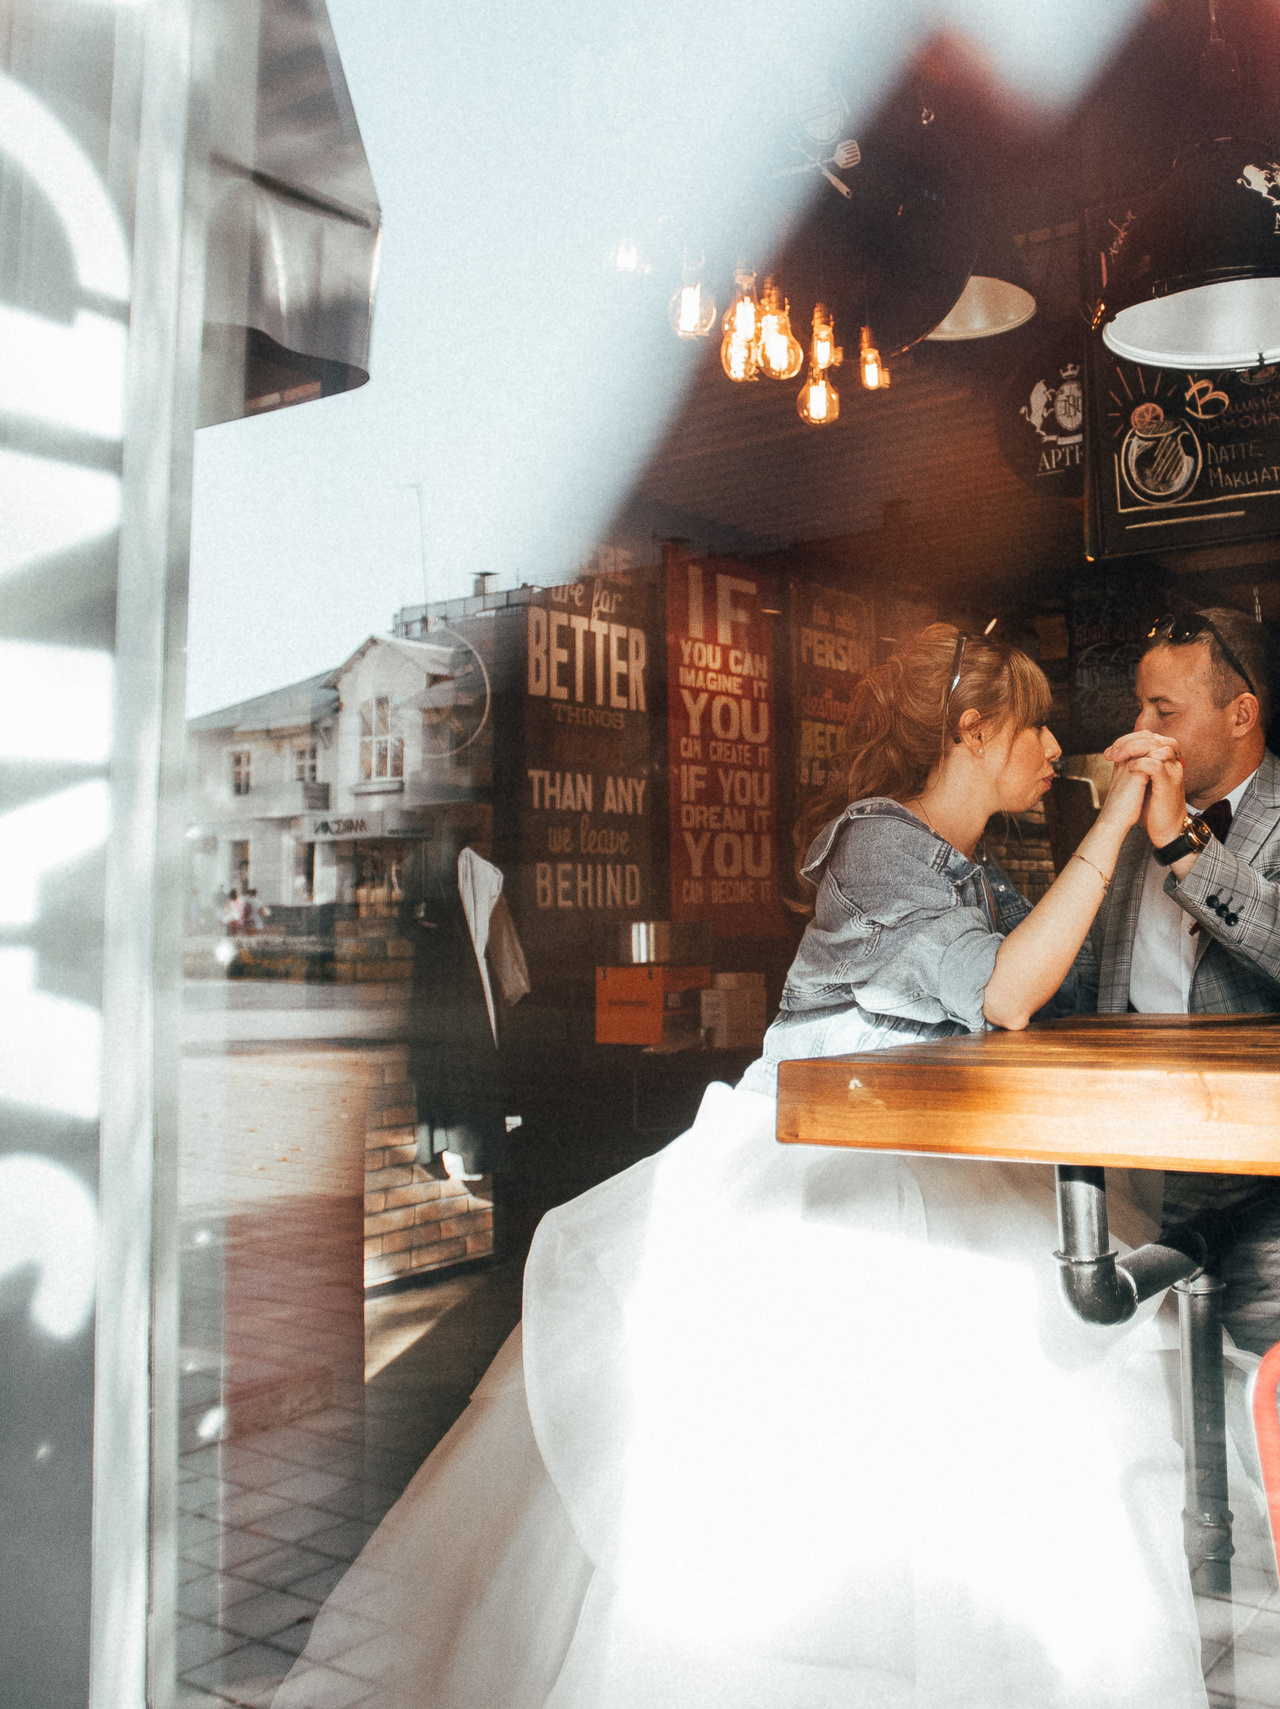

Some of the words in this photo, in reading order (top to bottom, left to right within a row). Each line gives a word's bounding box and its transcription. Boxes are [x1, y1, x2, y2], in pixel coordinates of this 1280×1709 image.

[687, 565, 758, 646] IF
[527, 606, 647, 712] BETTER
[679, 639, 722, 671] YOU
[728, 649, 769, 680] CAN
[679, 666, 743, 695] IMAGINE
[752, 679, 769, 700] IT
[552, 703, 626, 731] THINGS
[679, 688, 770, 744] YOU
[679, 736, 702, 760] CAN
[709, 740, 752, 766] CREATE
[757, 745, 771, 768] IT
[527, 769, 593, 812] THAN
[603, 776, 647, 815] ANY
[680, 764, 708, 802] IF
[717, 768, 771, 807] YOU
[579, 815, 630, 855] leave
[681, 804, 747, 831] DREAM
[753, 809, 772, 832] IT
[682, 830, 773, 879] YOU
[535, 863, 641, 909] BEHIND
